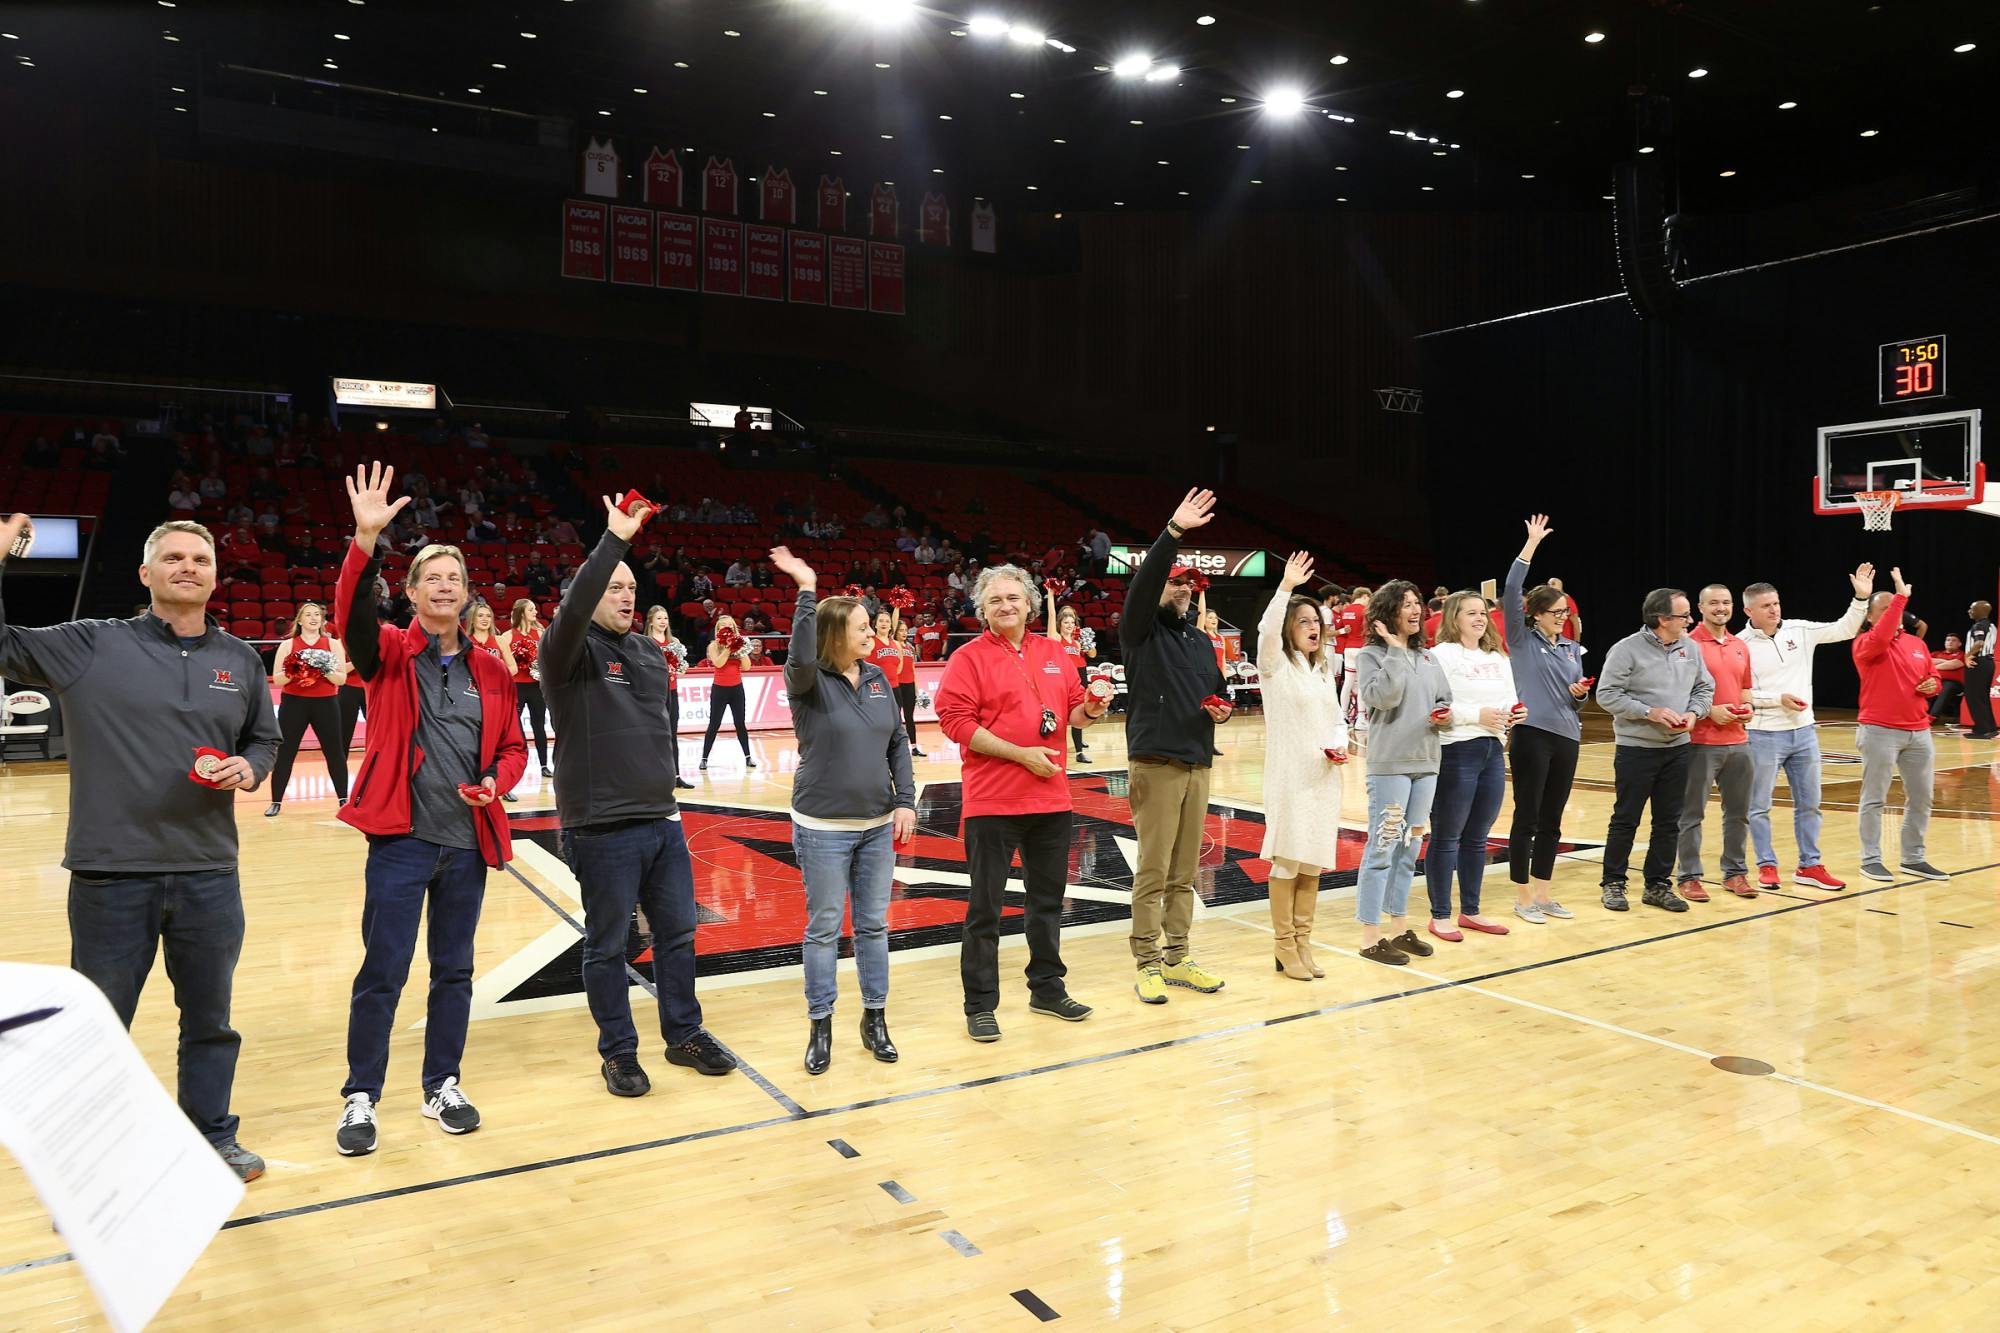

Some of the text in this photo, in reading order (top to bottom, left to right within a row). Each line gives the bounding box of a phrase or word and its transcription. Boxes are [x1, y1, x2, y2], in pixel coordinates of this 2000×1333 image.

[597, 161, 605, 173] 5
[656, 170, 670, 183] 32
[714, 176, 726, 188] 12
[772, 188, 784, 200] 10
[569, 207, 601, 221] NCAA
[616, 213, 648, 226] NCAA
[664, 220, 692, 233] NCAA
[708, 226, 738, 238] NIT
[750, 231, 778, 244] NCAA
[794, 238, 821, 249] NCAA
[569, 239, 601, 256] 1958
[617, 245, 648, 262] 1969
[835, 243, 862, 255] NCAA
[873, 249, 899, 260] NIT
[708, 256, 737, 272] 1993
[750, 260, 779, 277] 1995
[793, 266, 822, 283] 1999
[1899, 343, 1938, 363] 7:50
[1895, 362, 1933, 395] 30
[877, 647, 899, 659] MIAM
